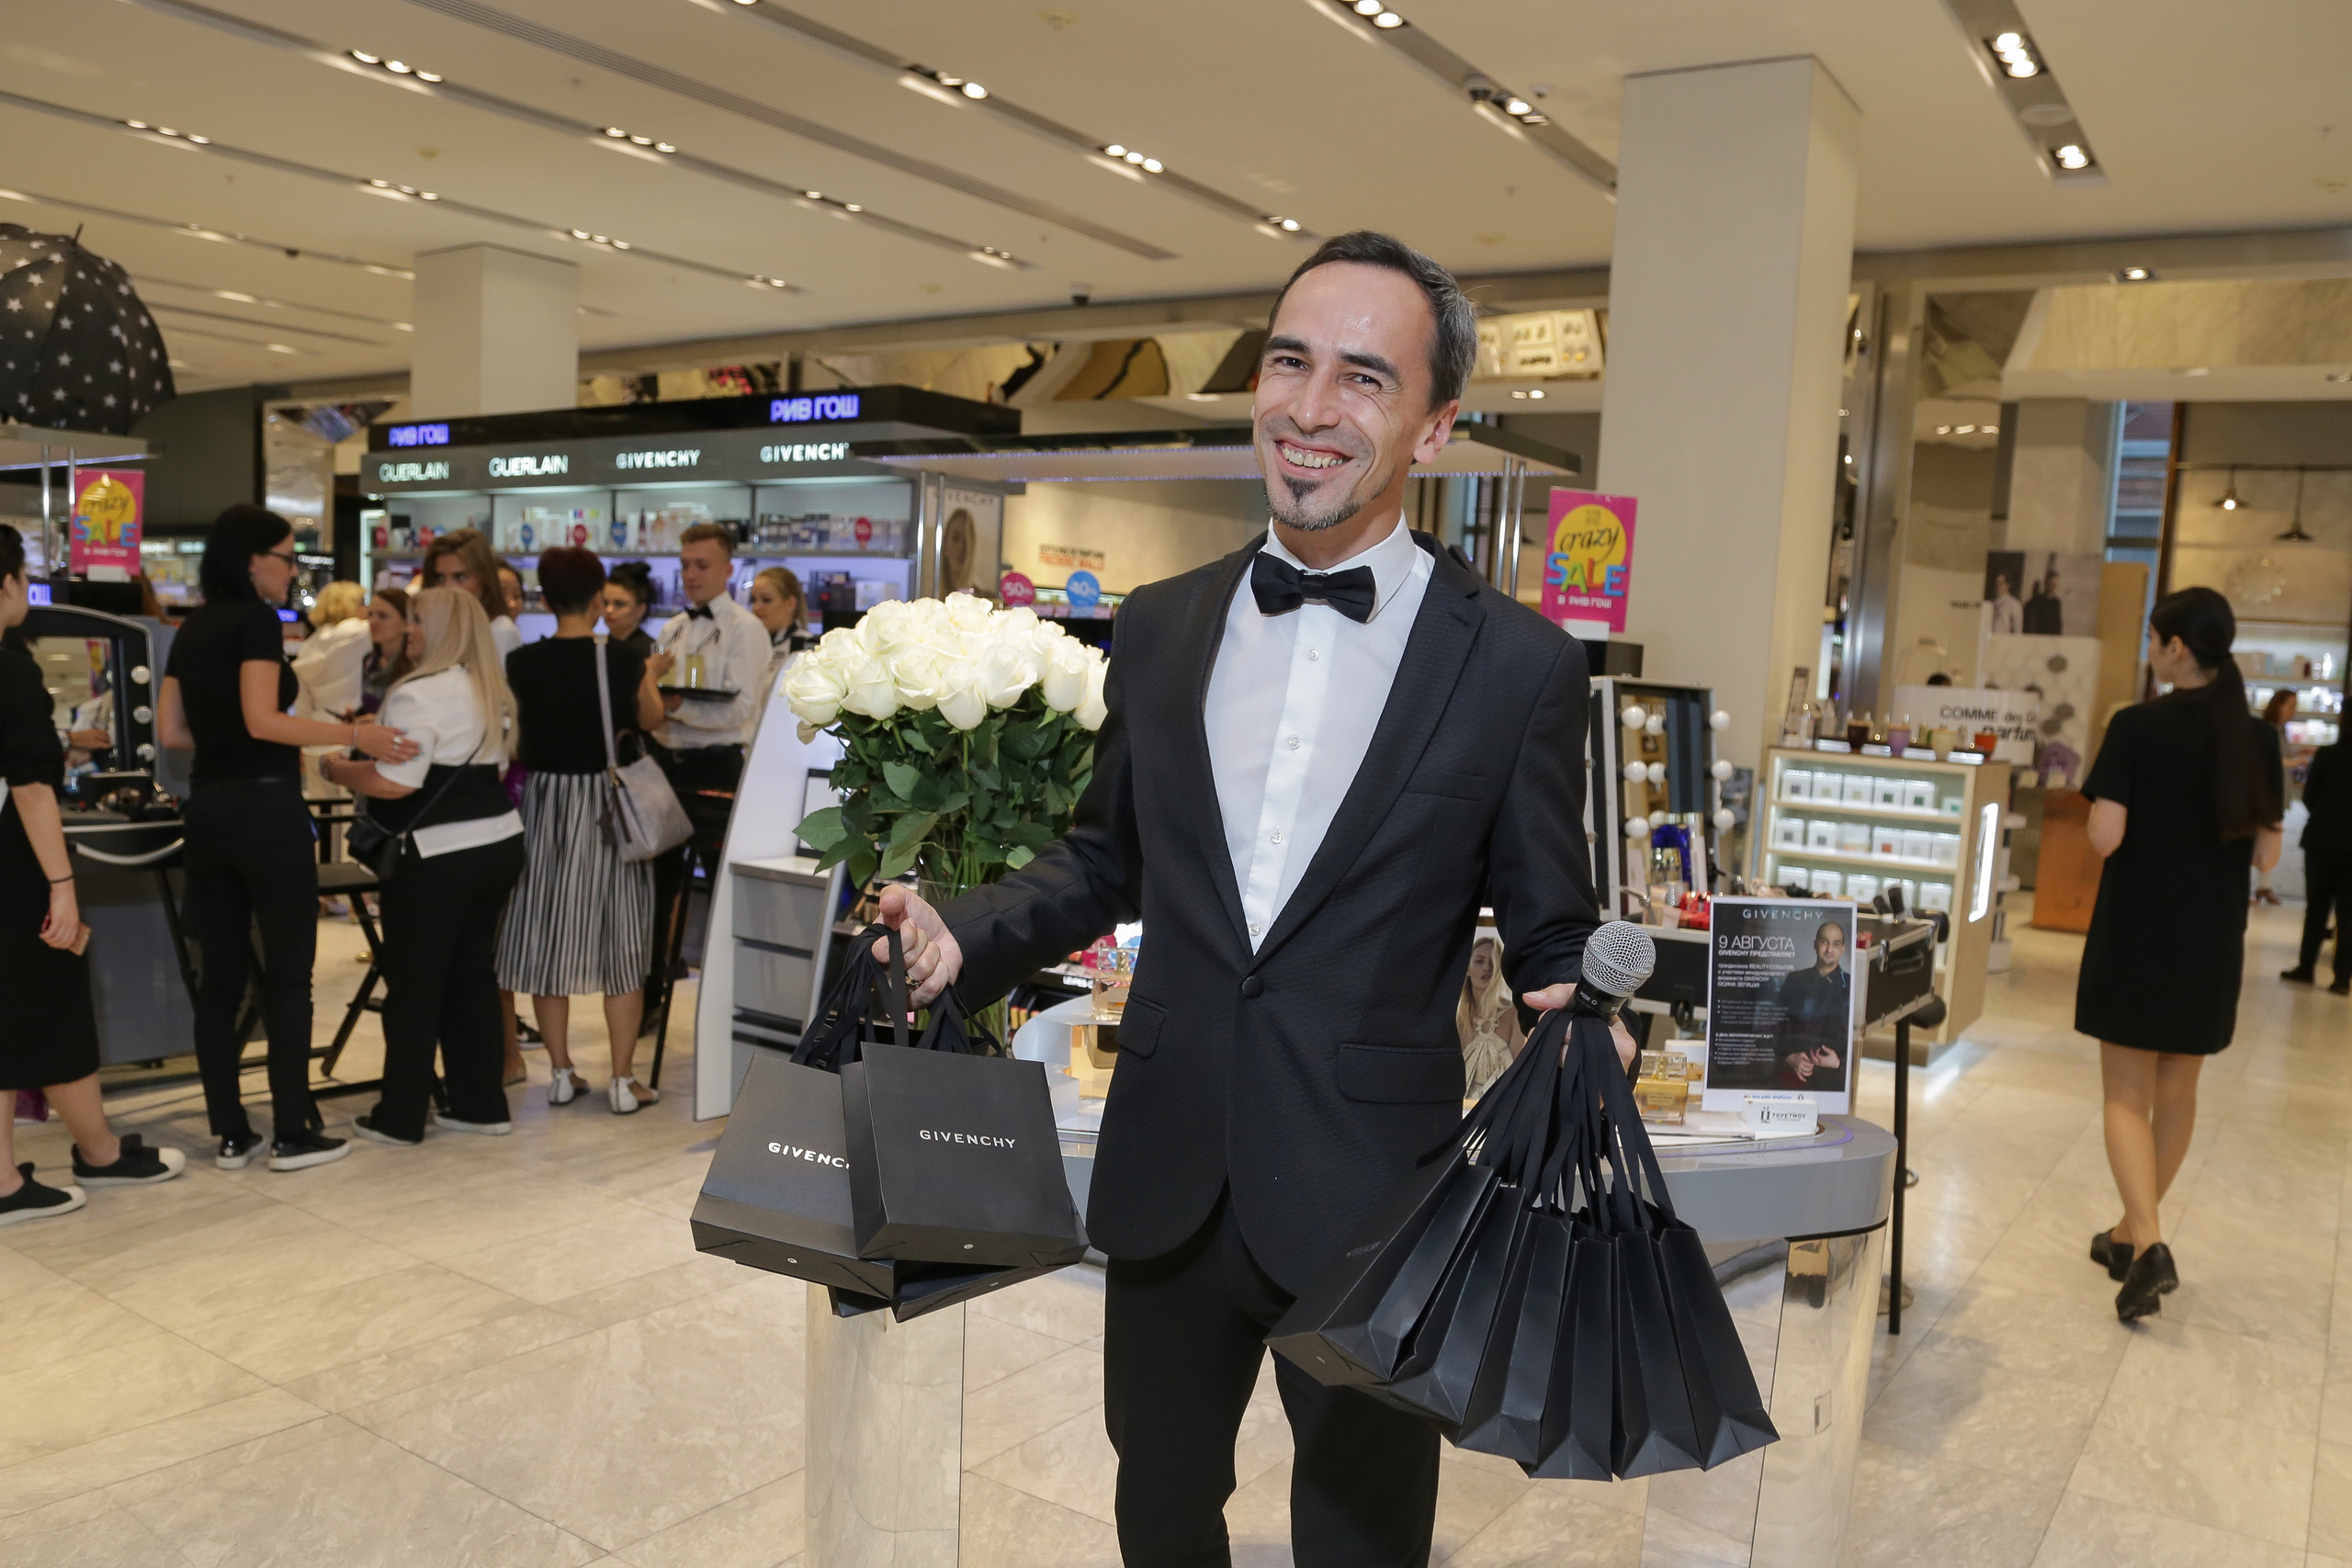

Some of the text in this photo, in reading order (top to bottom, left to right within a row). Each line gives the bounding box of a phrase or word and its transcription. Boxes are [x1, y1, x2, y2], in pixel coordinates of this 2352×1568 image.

[770, 395, 859, 423] РИВ ГОШ
[418, 423, 449, 445] ГОШ
[616, 449, 701, 469] GIVENCHY
[760, 442, 850, 463] GIVENCH
[379, 461, 449, 482] GUERLAIN
[489, 455, 569, 478] GUERLAIN
[74, 515, 138, 547] SALE
[1560, 526, 1621, 566] crazy
[1546, 552, 1627, 596] SALE
[28, 583, 52, 606] ОШ
[1940, 705, 1997, 721] COMME
[1742, 908, 1824, 920] GIVENCHY
[1718, 935, 1795, 951] 9 АВГУСТА
[1718, 949, 1748, 957] GIVENCHY
[919, 1130, 1016, 1149] GIVENCHY
[768, 1142, 850, 1169] GIVENC
